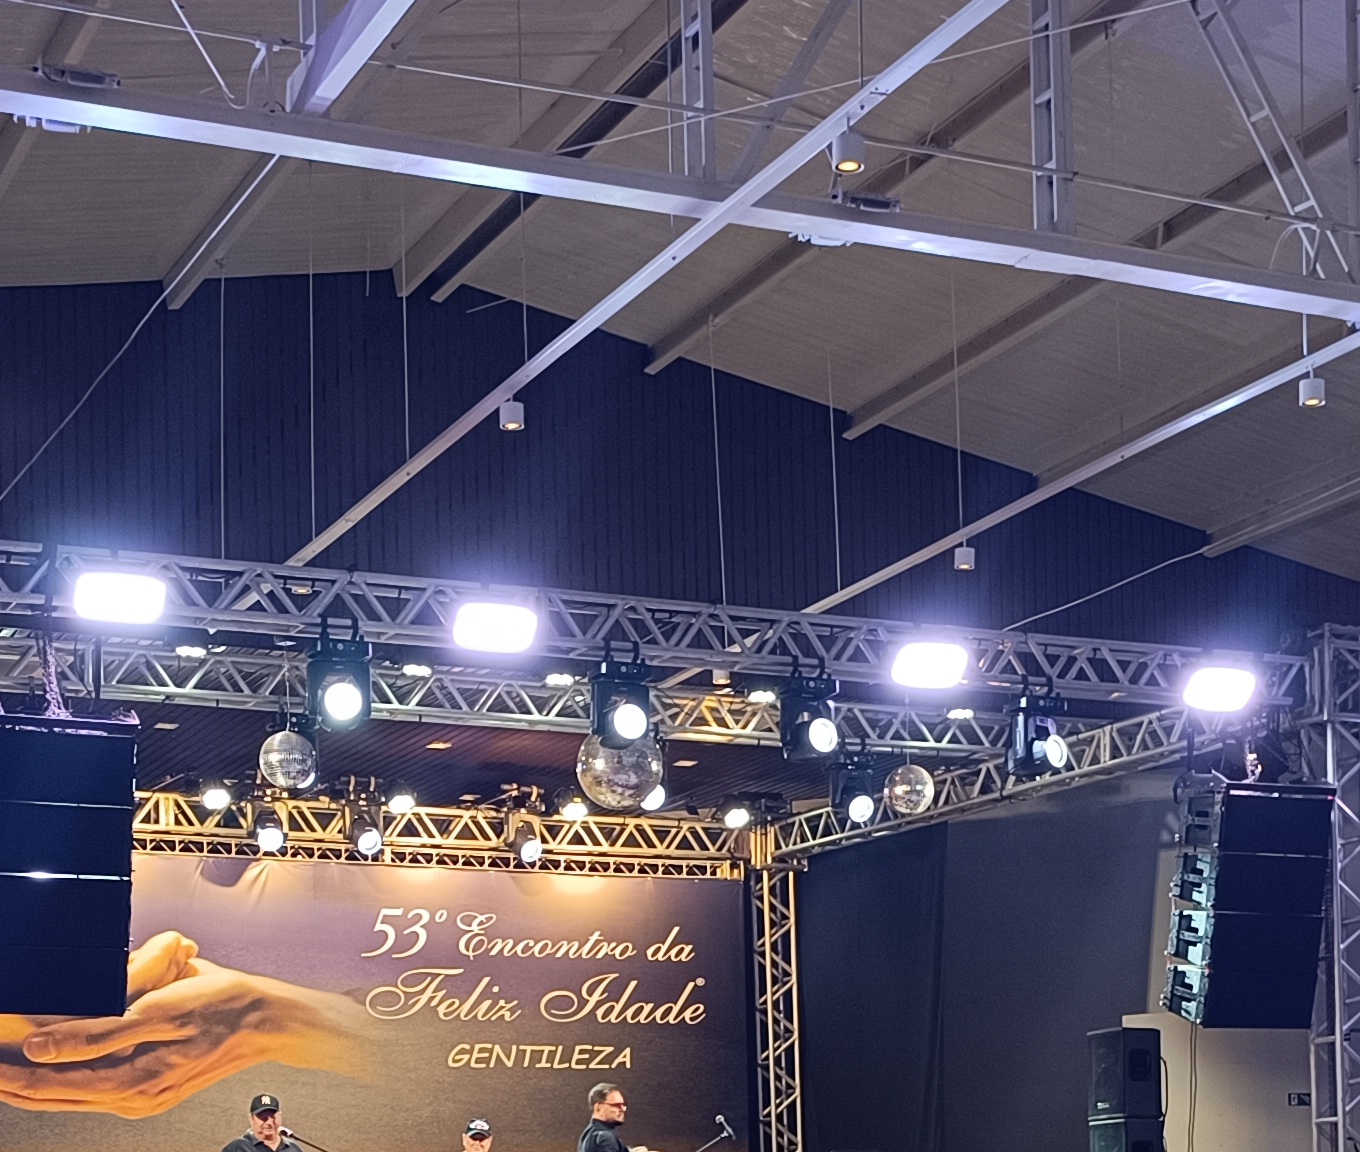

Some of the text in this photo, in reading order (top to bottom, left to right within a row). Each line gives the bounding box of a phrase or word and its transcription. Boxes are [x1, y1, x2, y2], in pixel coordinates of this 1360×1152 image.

[456, 911, 637, 961] Encontro
[645, 925, 696, 963] da
[364, 967, 522, 1022] Feliz
[446, 1042, 633, 1070] GENTILEZA
